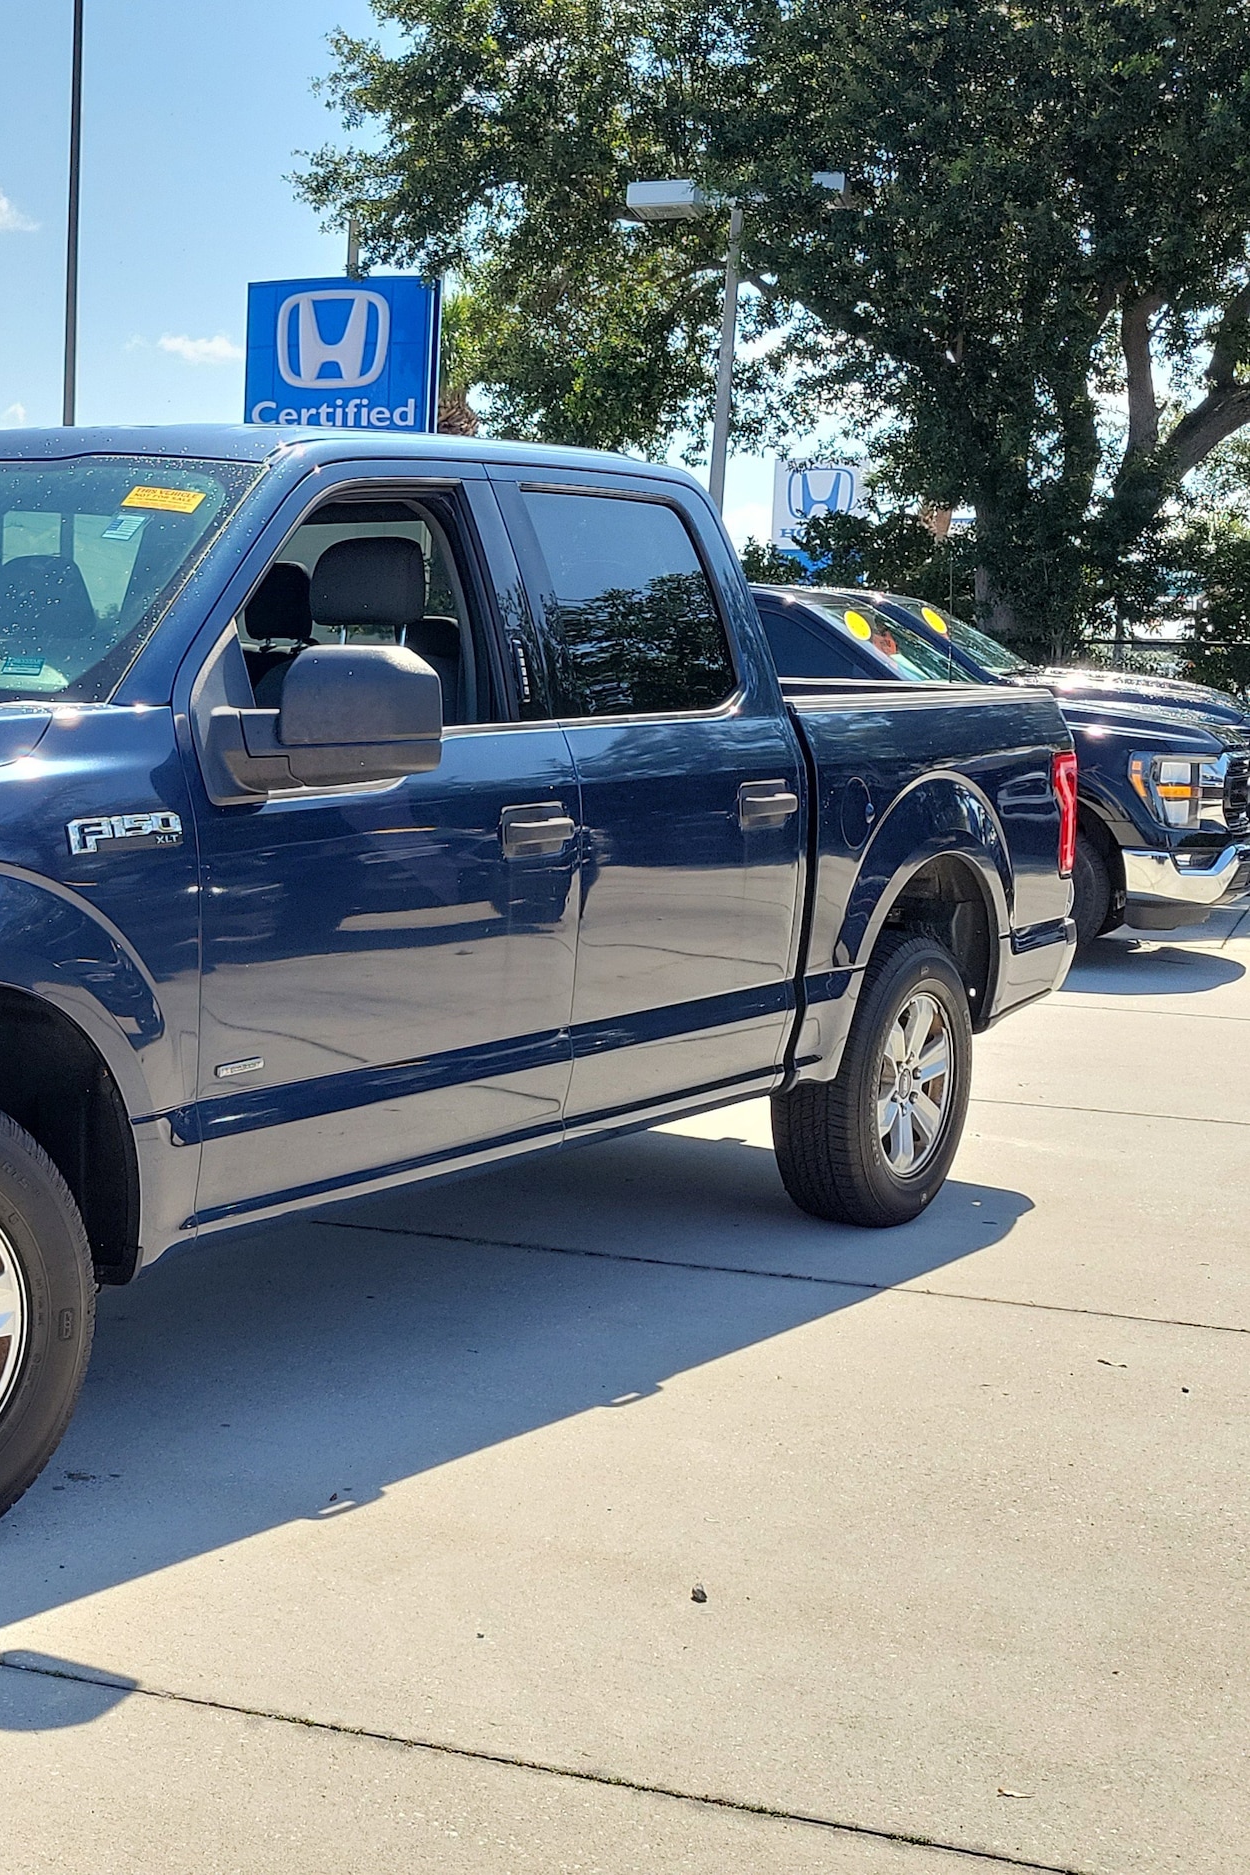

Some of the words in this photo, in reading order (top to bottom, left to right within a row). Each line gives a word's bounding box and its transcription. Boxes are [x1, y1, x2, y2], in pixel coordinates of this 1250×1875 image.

[251, 398, 416, 427] Certified
[136, 487, 158, 495] THIS
[159, 489, 200, 500] VEHICLE
[156, 834, 179, 844] XLT
